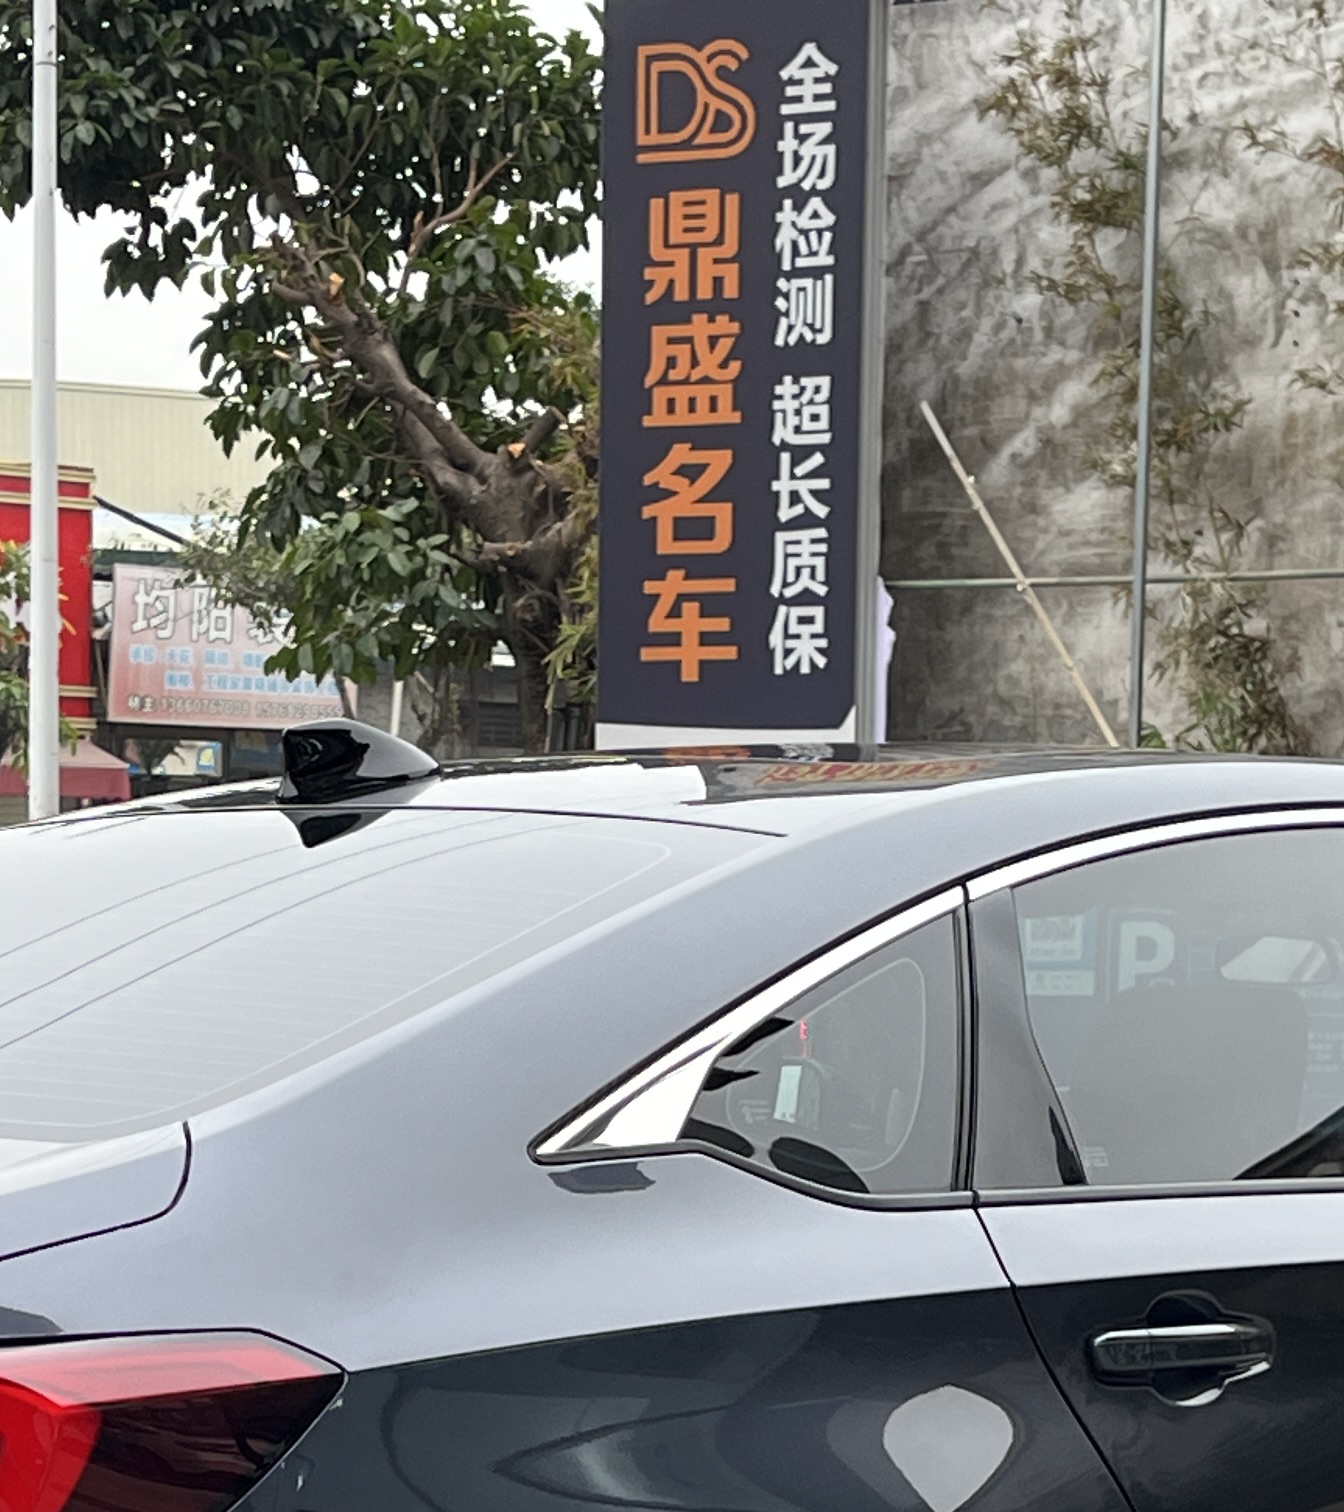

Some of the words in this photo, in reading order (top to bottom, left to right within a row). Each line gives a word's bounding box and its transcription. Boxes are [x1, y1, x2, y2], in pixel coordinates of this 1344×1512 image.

[636, 39, 756, 164] DS
[774, 42, 840, 348] 全场检测
[640, 188, 743, 684] 鼎盛名车
[768, 375, 834, 676] 超长质保
